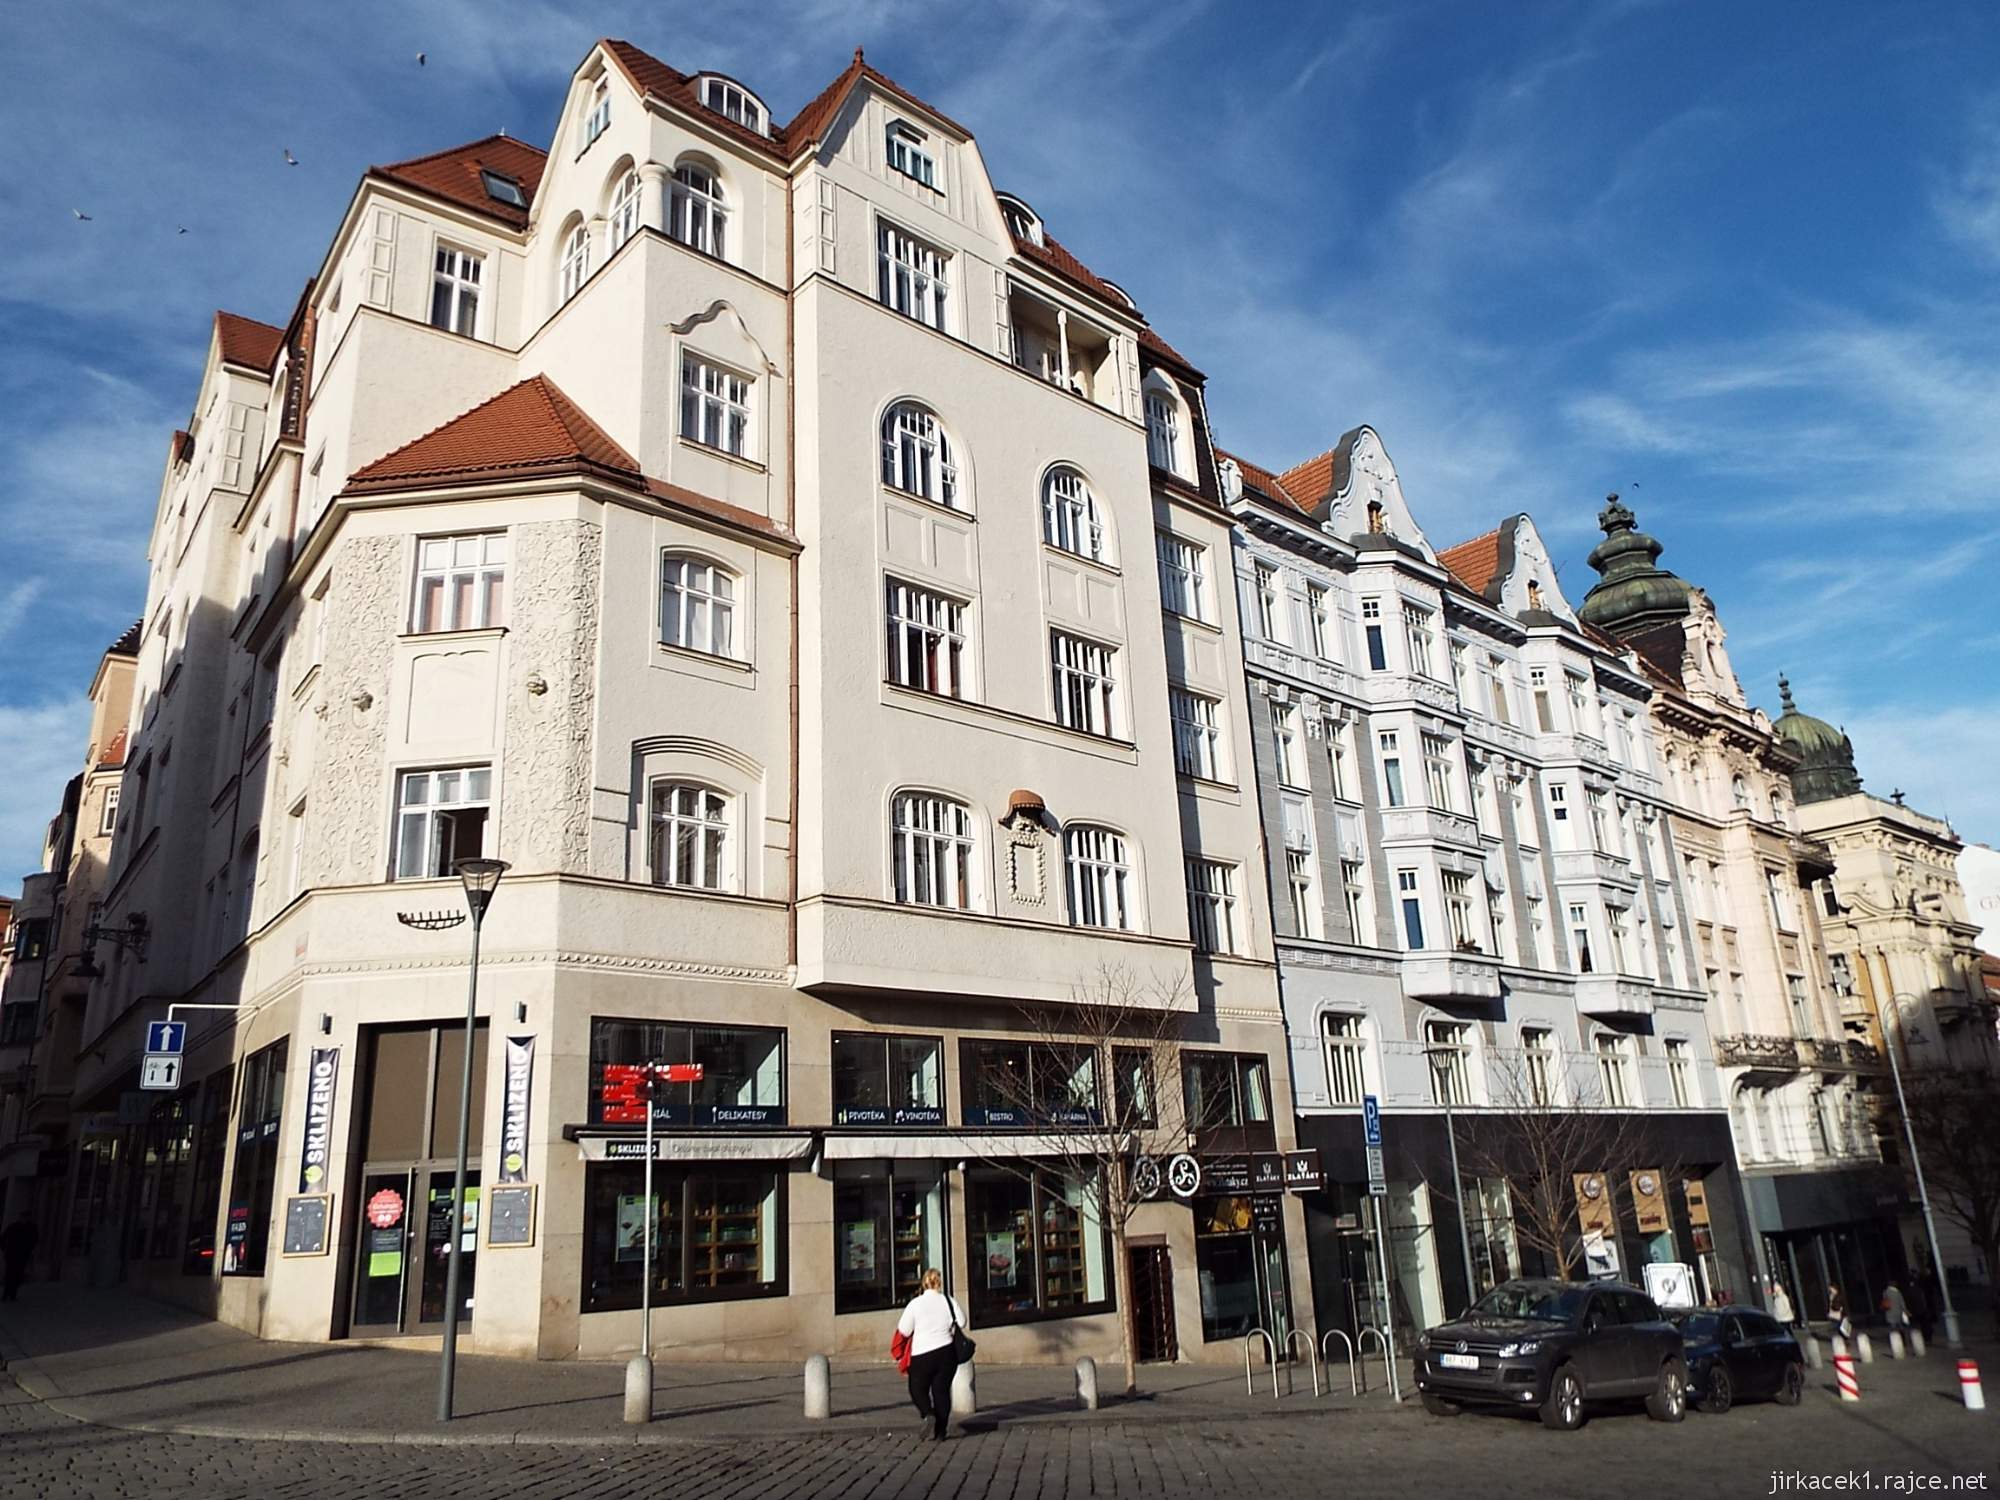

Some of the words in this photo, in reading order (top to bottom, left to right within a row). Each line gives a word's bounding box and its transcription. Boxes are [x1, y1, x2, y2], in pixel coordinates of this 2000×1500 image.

[506, 1047, 529, 1152] SKLIZENO
[307, 1061, 333, 1164] SKLIZENO
[717, 1110, 768, 1121] DELIKATESY
[848, 1109, 886, 1121] PIVOTÉKA
[905, 1110, 941, 1121] VINOTÉKA
[989, 1112, 1014, 1122] BISTRO
